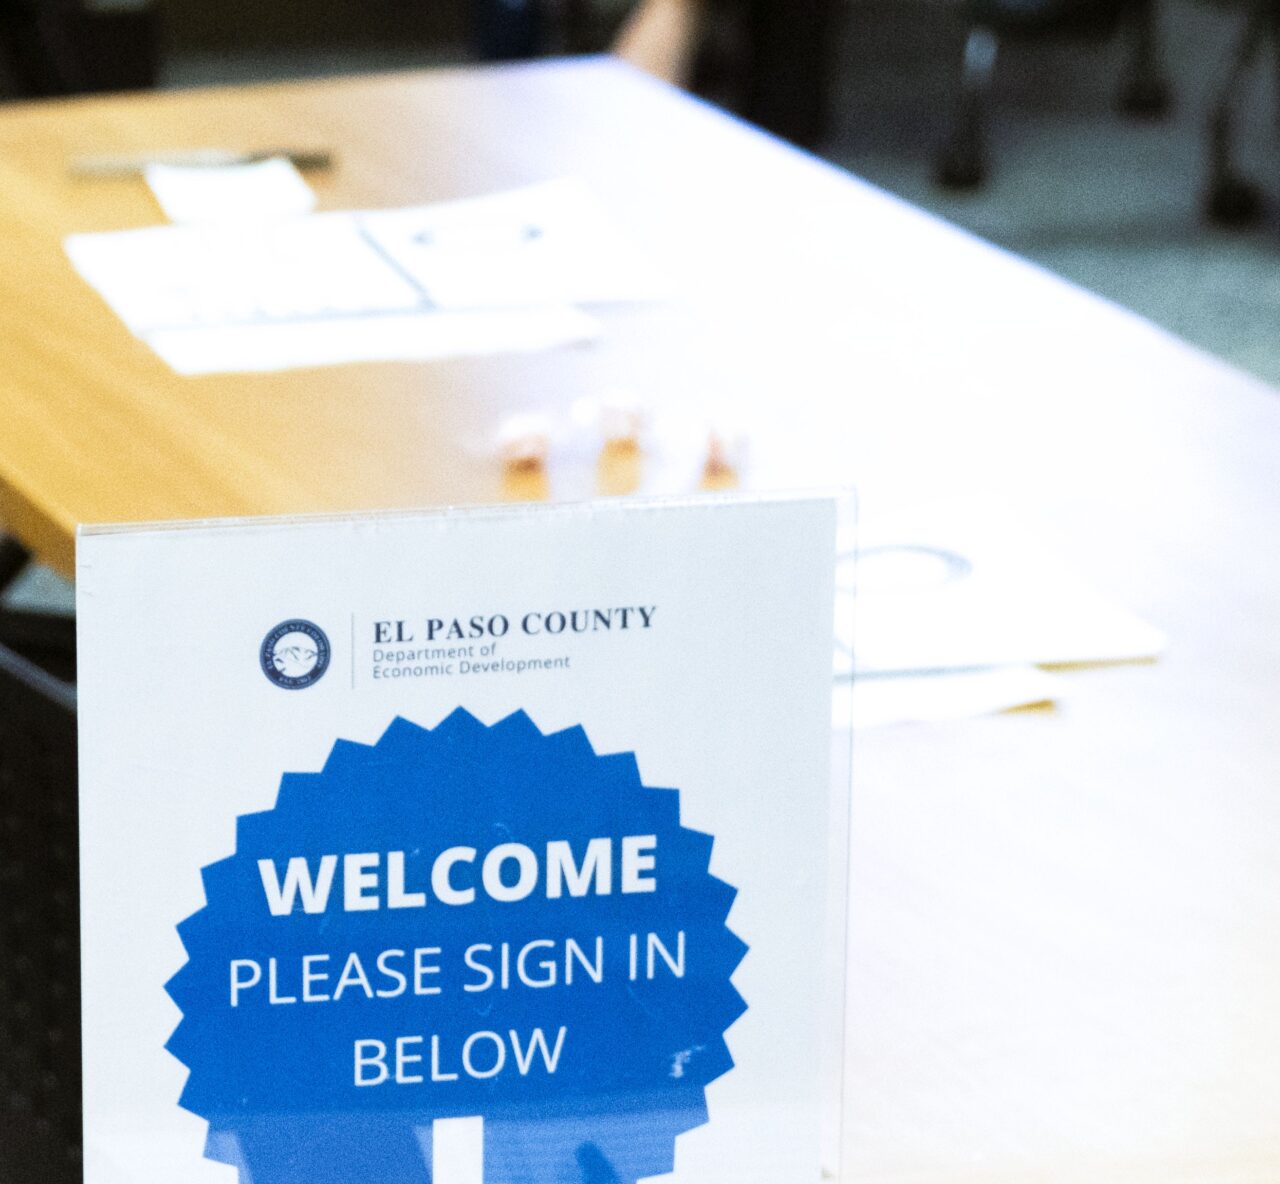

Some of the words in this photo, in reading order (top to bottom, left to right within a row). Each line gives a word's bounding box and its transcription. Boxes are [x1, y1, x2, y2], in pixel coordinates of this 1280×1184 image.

[374, 620, 413, 643] EL
[426, 614, 509, 641] PASO
[520, 606, 655, 635] COUNTY
[372, 645, 474, 666] Department
[479, 641, 497, 657] of
[372, 661, 452, 679] Economic
[458, 655, 570, 674] Development
[257, 833, 657, 916] WELCOME
[229, 946, 441, 1007] PLEASE
[463, 935, 603, 992] SIGN
[628, 929, 685, 981] IN
[353, 1025, 566, 1087] BELOW
